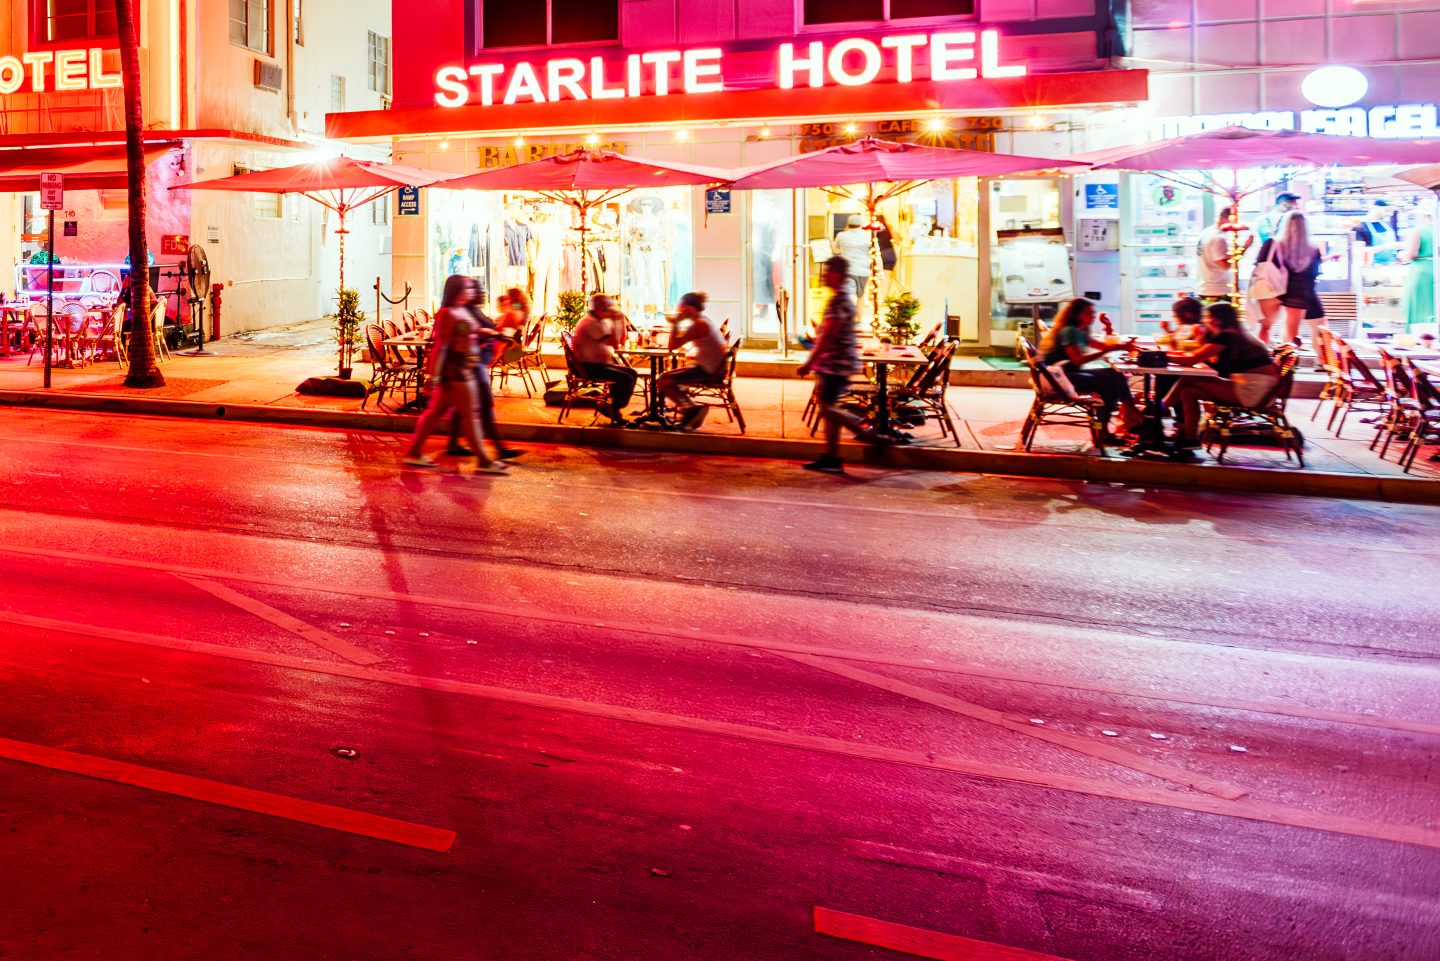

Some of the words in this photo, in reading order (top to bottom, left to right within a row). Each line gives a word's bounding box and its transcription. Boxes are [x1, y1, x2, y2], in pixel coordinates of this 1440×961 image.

[434, 47, 724, 109] STARLITE
[778, 29, 1028, 90] HOTEL
[47, 174, 57, 182] NO
